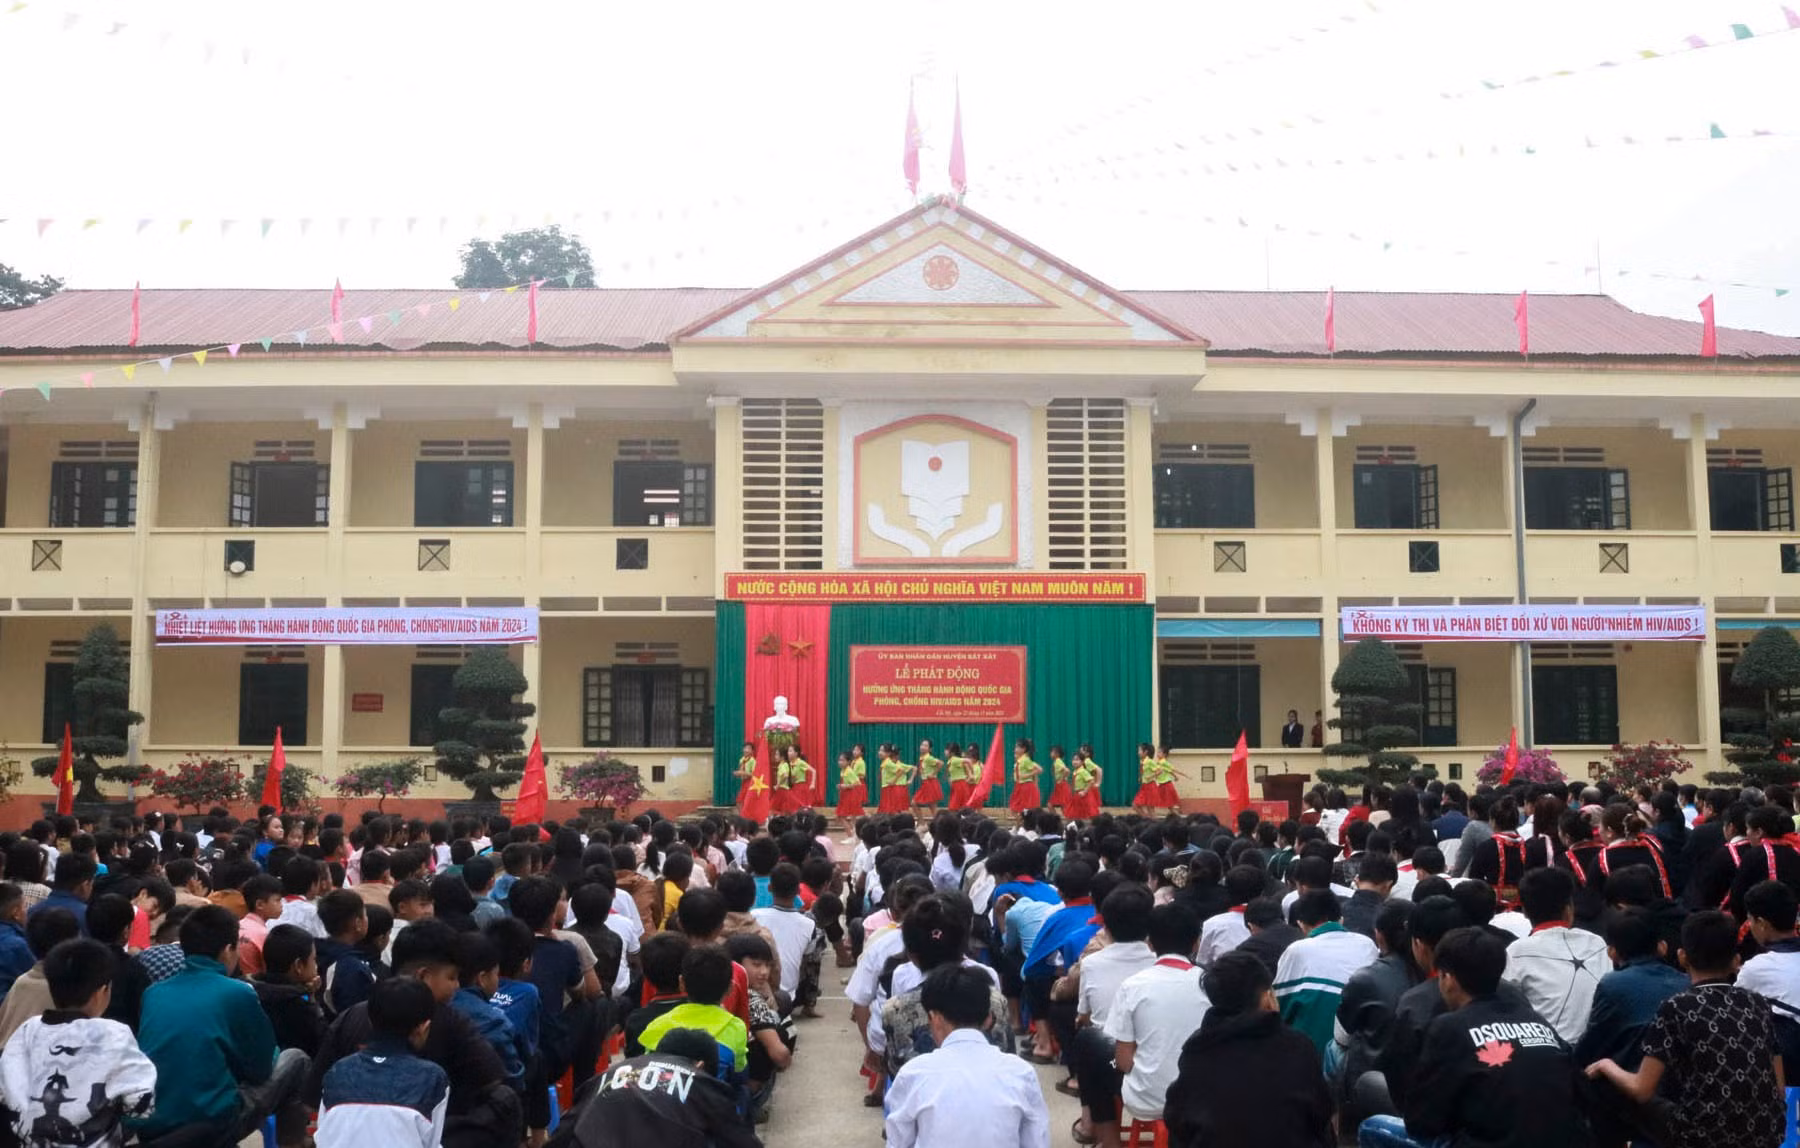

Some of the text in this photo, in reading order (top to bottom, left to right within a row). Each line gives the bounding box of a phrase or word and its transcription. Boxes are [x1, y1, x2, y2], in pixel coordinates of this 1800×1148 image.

[737, 578, 1134, 597] NƯỚC CỘNG HÒA XÃ HỘI CHỦ NGHĨA VIỆT NAM MUÔN NĂM !
[208, 615, 237, 634] HƯỞNG
[239, 616, 255, 634] ỨNG
[258, 616, 285, 634] THÁNG
[287, 617, 309, 634] HÀNH
[312, 616, 334, 636] ĐỘNG
[337, 614, 359, 634] QUỐC
[361, 619, 375, 634] GIA
[441, 618, 477, 633] HIV/AIDS
[480, 616, 499, 633] NĂM
[502, 619, 521, 633] 2024
[1353, 615, 1391, 633] KHÔNG
[1395, 615, 1409, 632] KỲ
[1413, 618, 1429, 635] THỊ
[1433, 615, 1447, 632] VÀ
[1451, 615, 1480, 632] PHÂN
[1484, 615, 1508, 634] BIỆT
[1512, 613, 1530, 632] ĐỐI
[1533, 613, 1548, 632] XỬ
[1551, 613, 1568, 632] VỚI
[1572, 614, 1605, 632] NGƯỜI
[1607, 613, 1643, 632] NHIỄM
[1646, 617, 1692, 632] HIV/AIDS
[912, 665, 945, 679] PHÁT
[946, 665, 980, 681] ĐỘNG
[907, 684, 932, 694] THÁNG
[955, 684, 976, 695] ĐỘNG
[977, 684, 998, 695] QUỐC
[999, 685, 1012, 694] GIA
[930, 697, 962, 706] HIV/AIDS
[982, 697, 1001, 706] 2024
